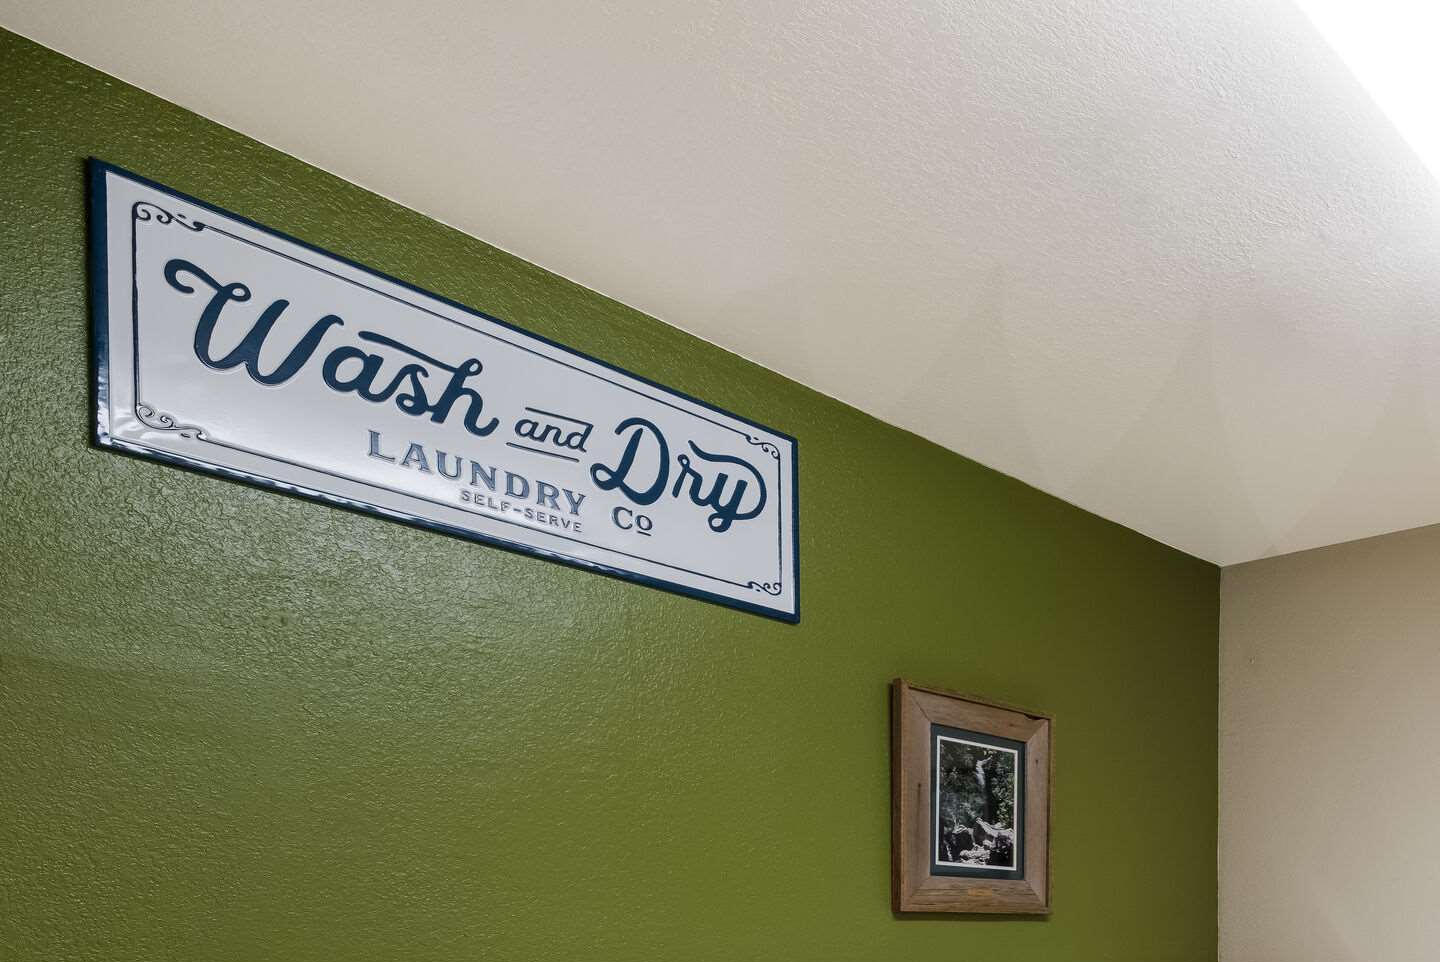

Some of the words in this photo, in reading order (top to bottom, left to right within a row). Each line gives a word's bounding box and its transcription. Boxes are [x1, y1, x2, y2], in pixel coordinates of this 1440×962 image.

[163, 258, 499, 437] Wash
[514, 408, 593, 453] and
[590, 417, 768, 533] Dry
[367, 430, 587, 516] LAUNDRY
[461, 490, 583, 533] SELF-SERVE
